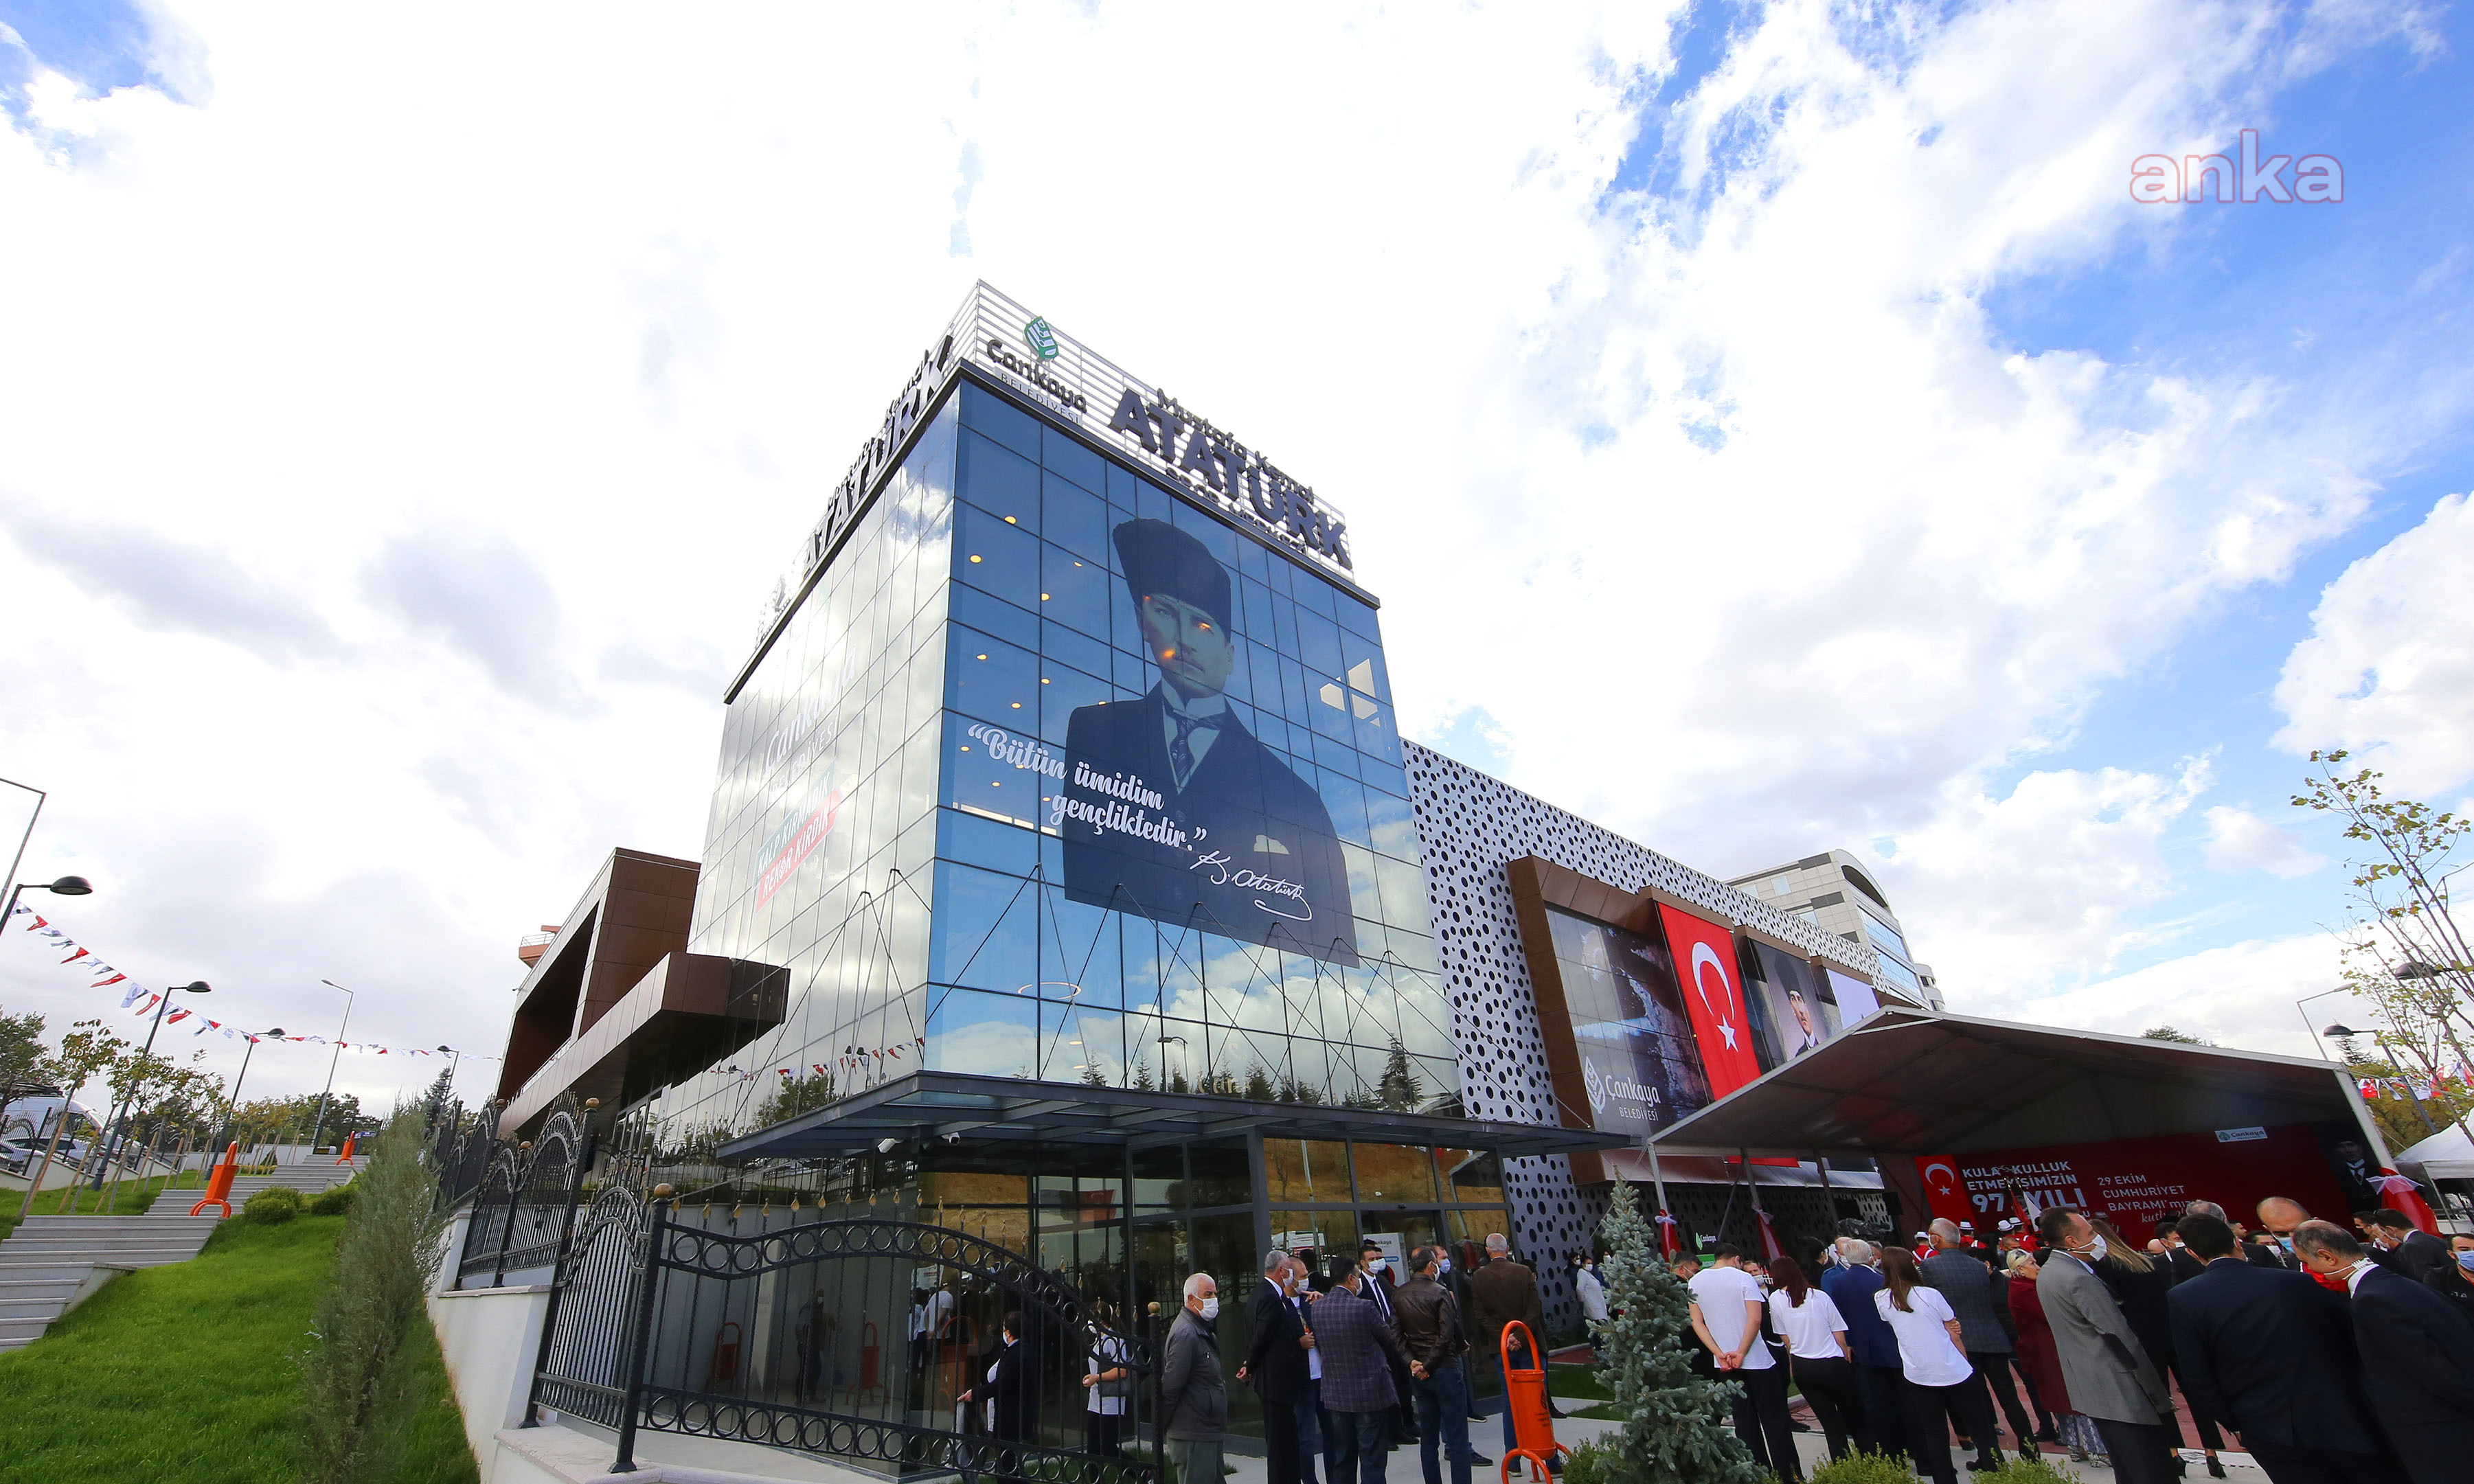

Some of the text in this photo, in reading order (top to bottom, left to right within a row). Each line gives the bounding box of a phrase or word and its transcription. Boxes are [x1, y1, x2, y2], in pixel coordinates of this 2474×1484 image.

[987, 339, 1087, 413] Çankaya
[1001, 373, 1081, 424] BELEDİYESİ
[1157, 387, 1315, 505] Mustafa Kemal
[1109, 388, 1353, 571] ATATÜRK
[1074, 761, 1165, 811] ümidim
[758, 770, 830, 877] KALP KIRMADIK
[795, 801, 830, 863] KIRDIK
[1605, 1075, 1661, 1108] Çankaya
[1619, 1106, 1659, 1121] BELEDİYESİ
[1962, 1161, 2072, 1178] KULA KULLUK
[2098, 1173, 2147, 1186] 29 EKİM
[2102, 1185, 2184, 1198] CUMHURİYET
